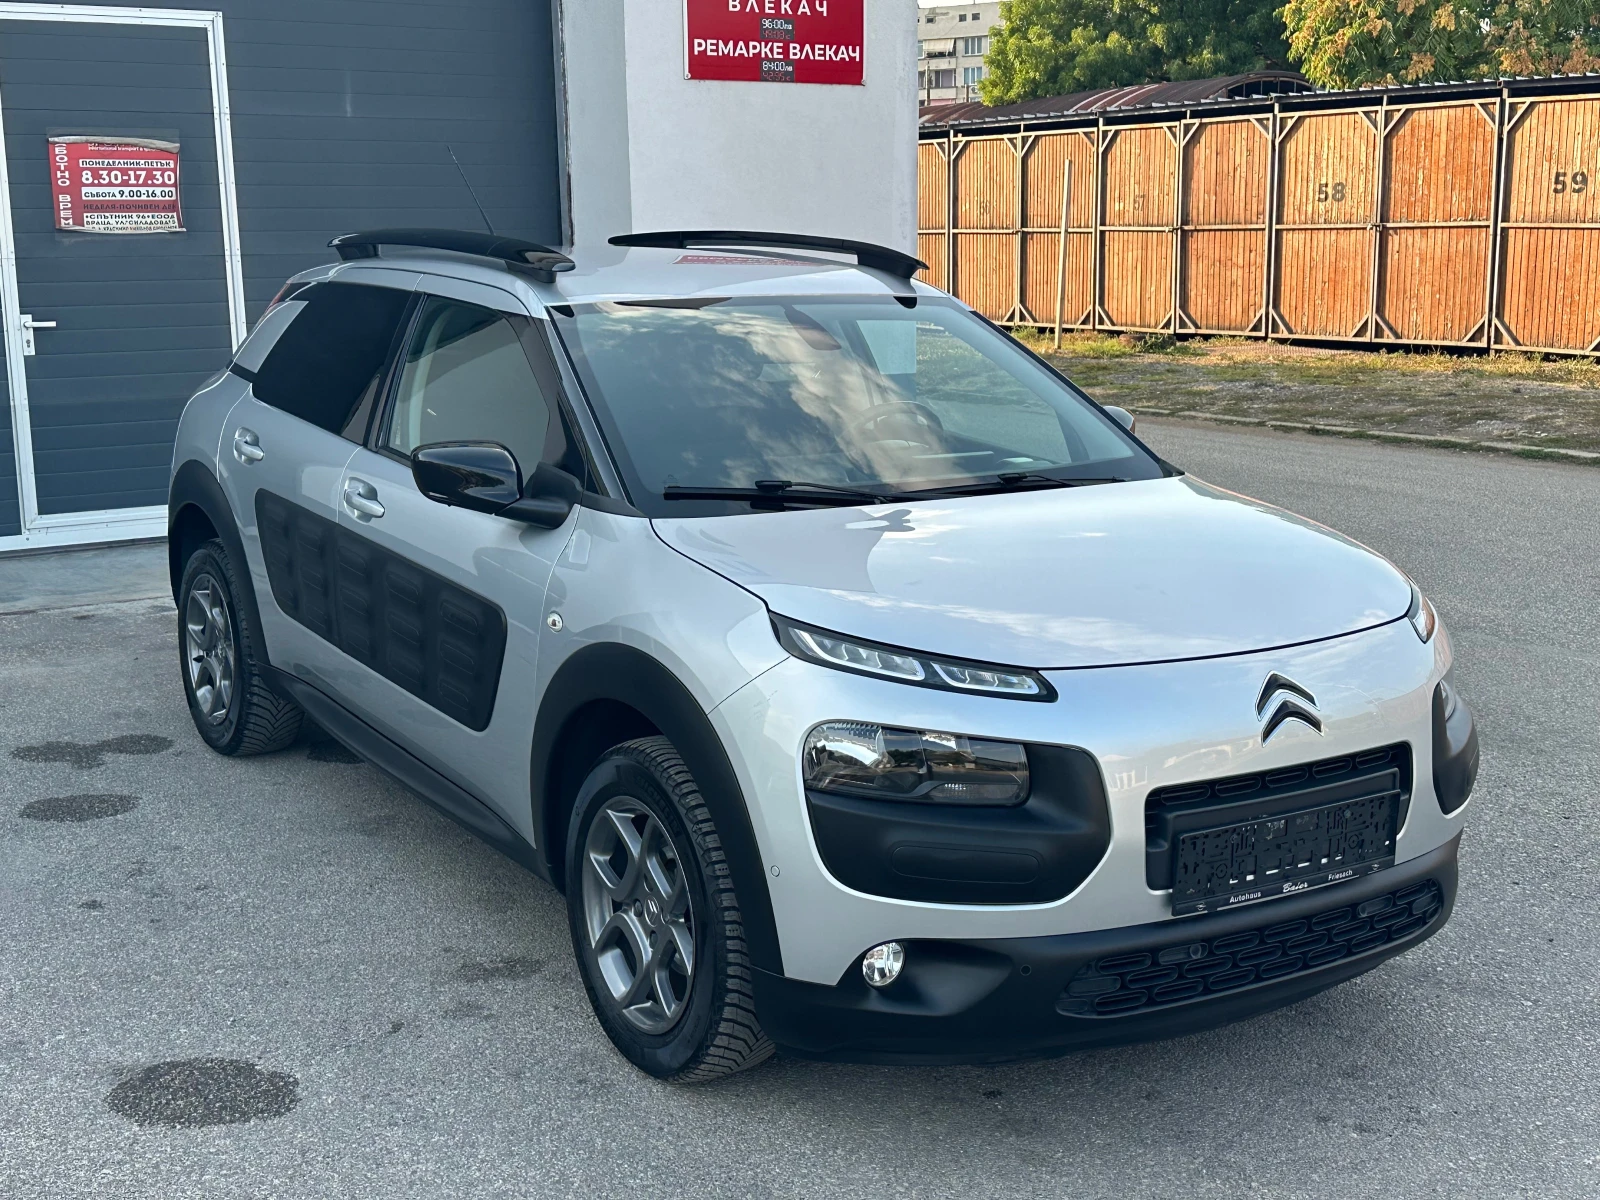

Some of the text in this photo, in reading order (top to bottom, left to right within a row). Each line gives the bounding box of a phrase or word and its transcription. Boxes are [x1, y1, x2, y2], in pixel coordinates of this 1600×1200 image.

[728, 0, 828, 16] ВЛЕКАЧ
[693, 38, 860, 62] РЕМАРКЕ ВЛЕКАЧ
[81, 170, 175, 184] 8.30-17.30
[1553, 171, 1588, 194] 59
[1317, 182, 1346, 202] 58
[1229, 890, 1262, 903] Autohaus
[1328, 869, 1353, 881] Friesach
